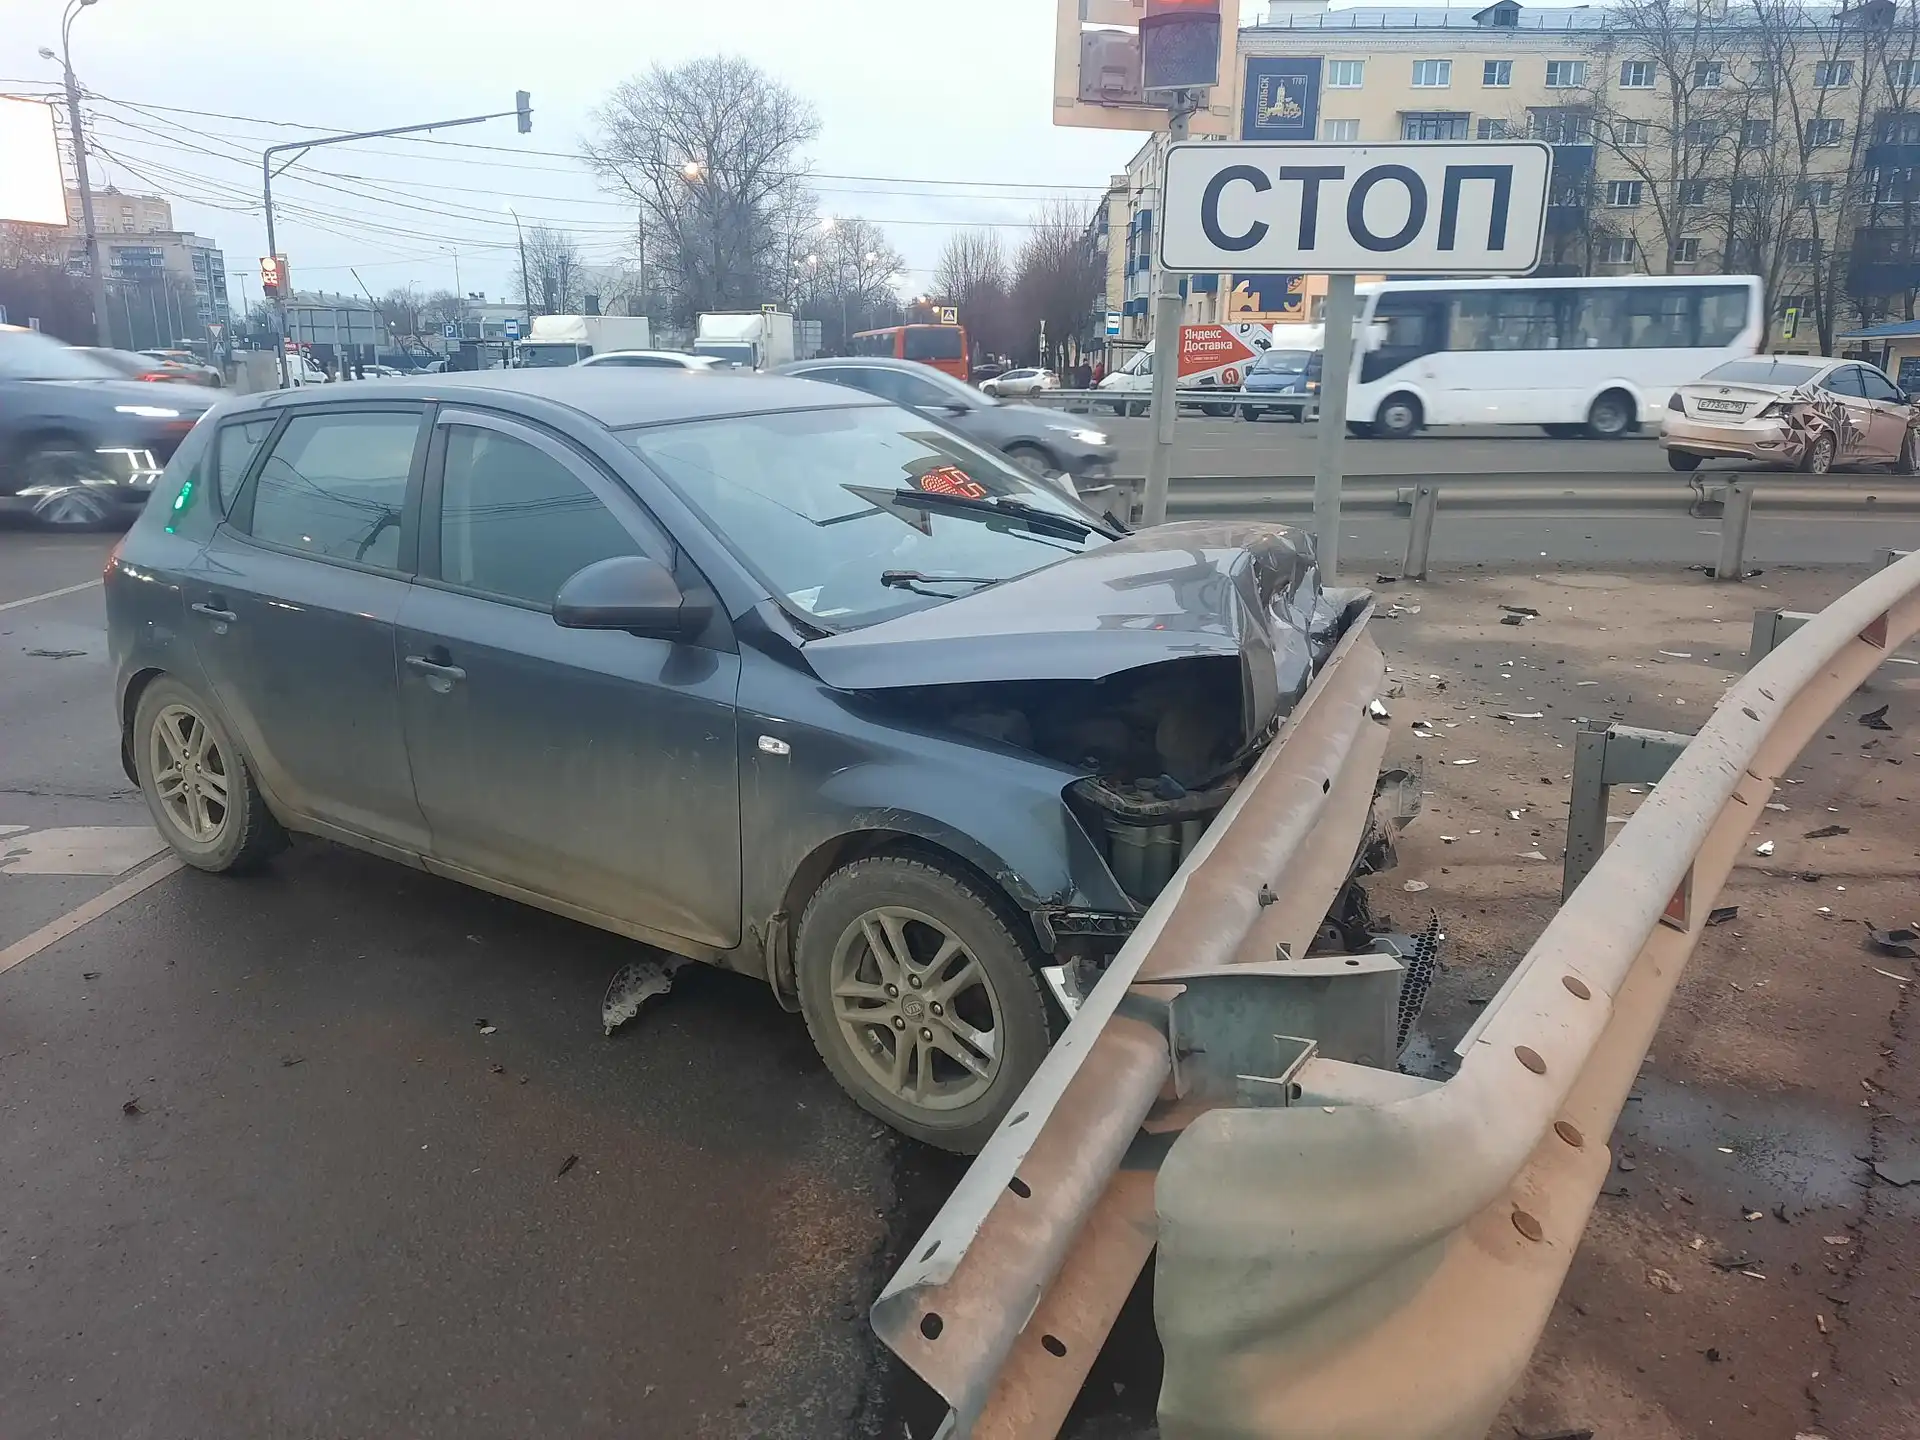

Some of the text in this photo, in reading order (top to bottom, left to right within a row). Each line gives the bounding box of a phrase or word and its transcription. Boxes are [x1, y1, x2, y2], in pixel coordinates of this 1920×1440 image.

[1292, 77, 1305, 85] 1781
[1200, 163, 1514, 252] СТОП
[1185, 329, 1222, 340] Яндекс
[1184, 340, 1233, 352] Доставка
